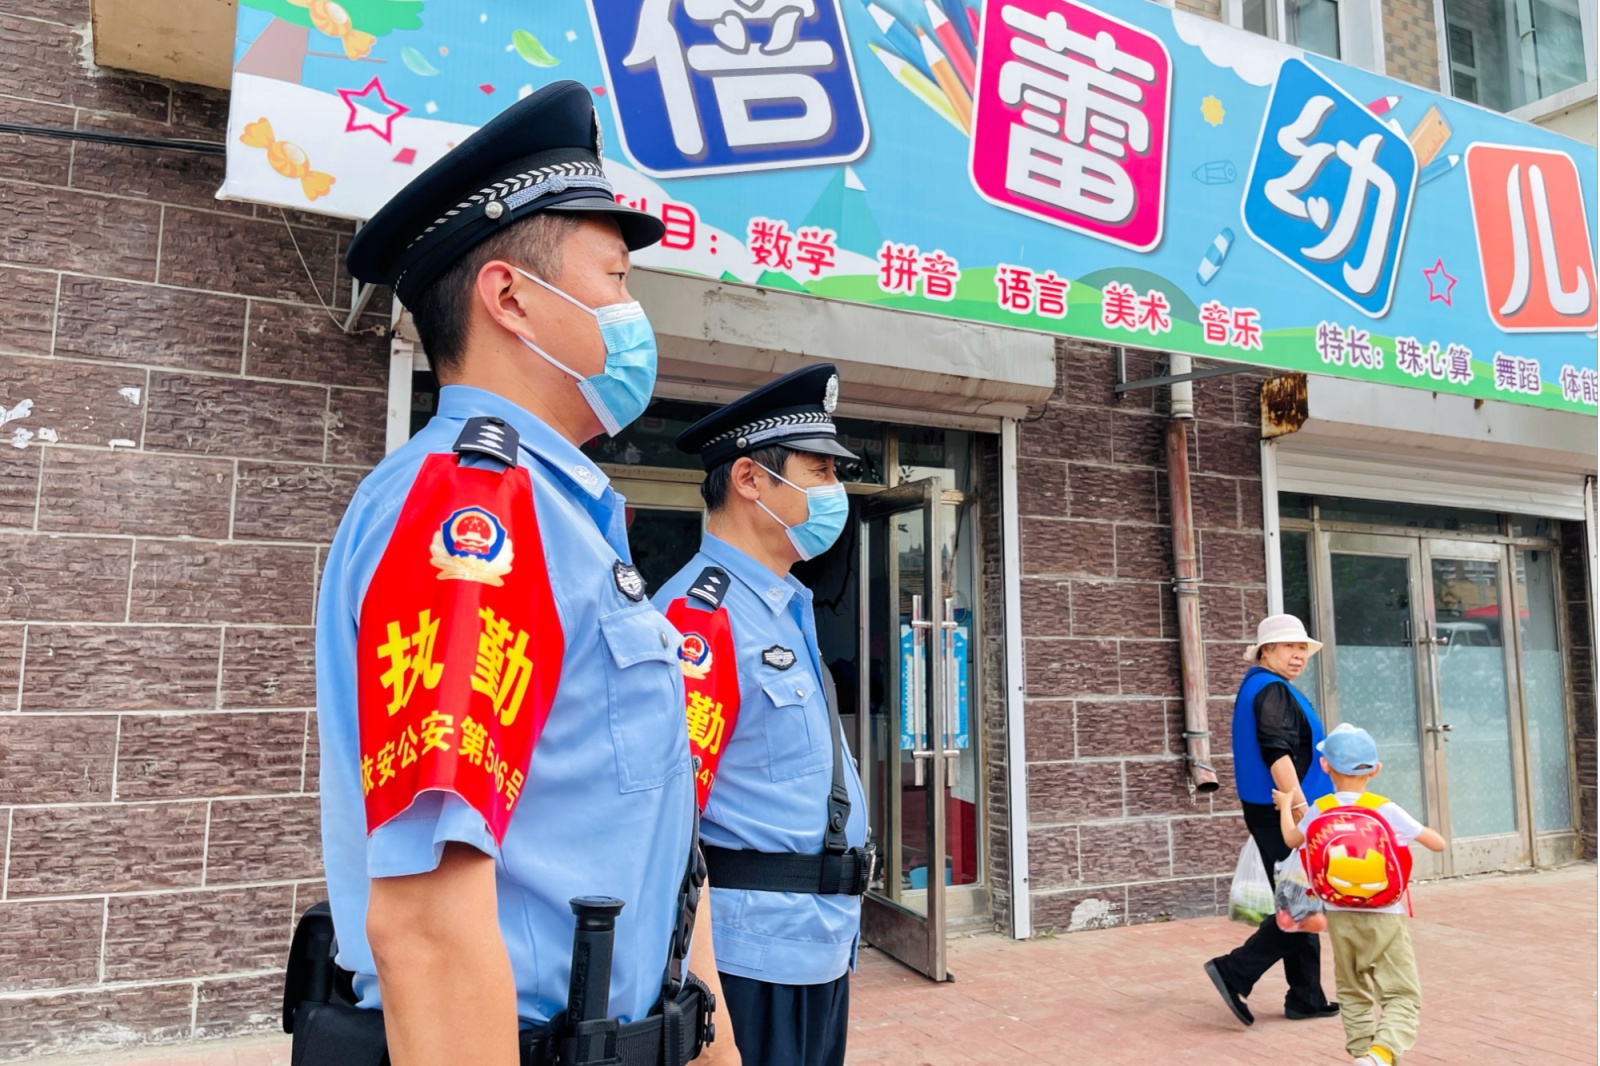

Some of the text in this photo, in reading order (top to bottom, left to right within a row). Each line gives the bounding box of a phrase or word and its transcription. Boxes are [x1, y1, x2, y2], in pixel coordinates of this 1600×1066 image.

[751, 221, 835, 276] 数学
[880, 245, 957, 297] 拼音
[998, 267, 1067, 315] 语言
[1105, 285, 1169, 331] 美术
[1202, 304, 1260, 347] 音乐
[1398, 340, 1472, 381] 珠心算
[1495, 354, 1540, 391] 舞蹈
[377, 606, 534, 727] 执勤
